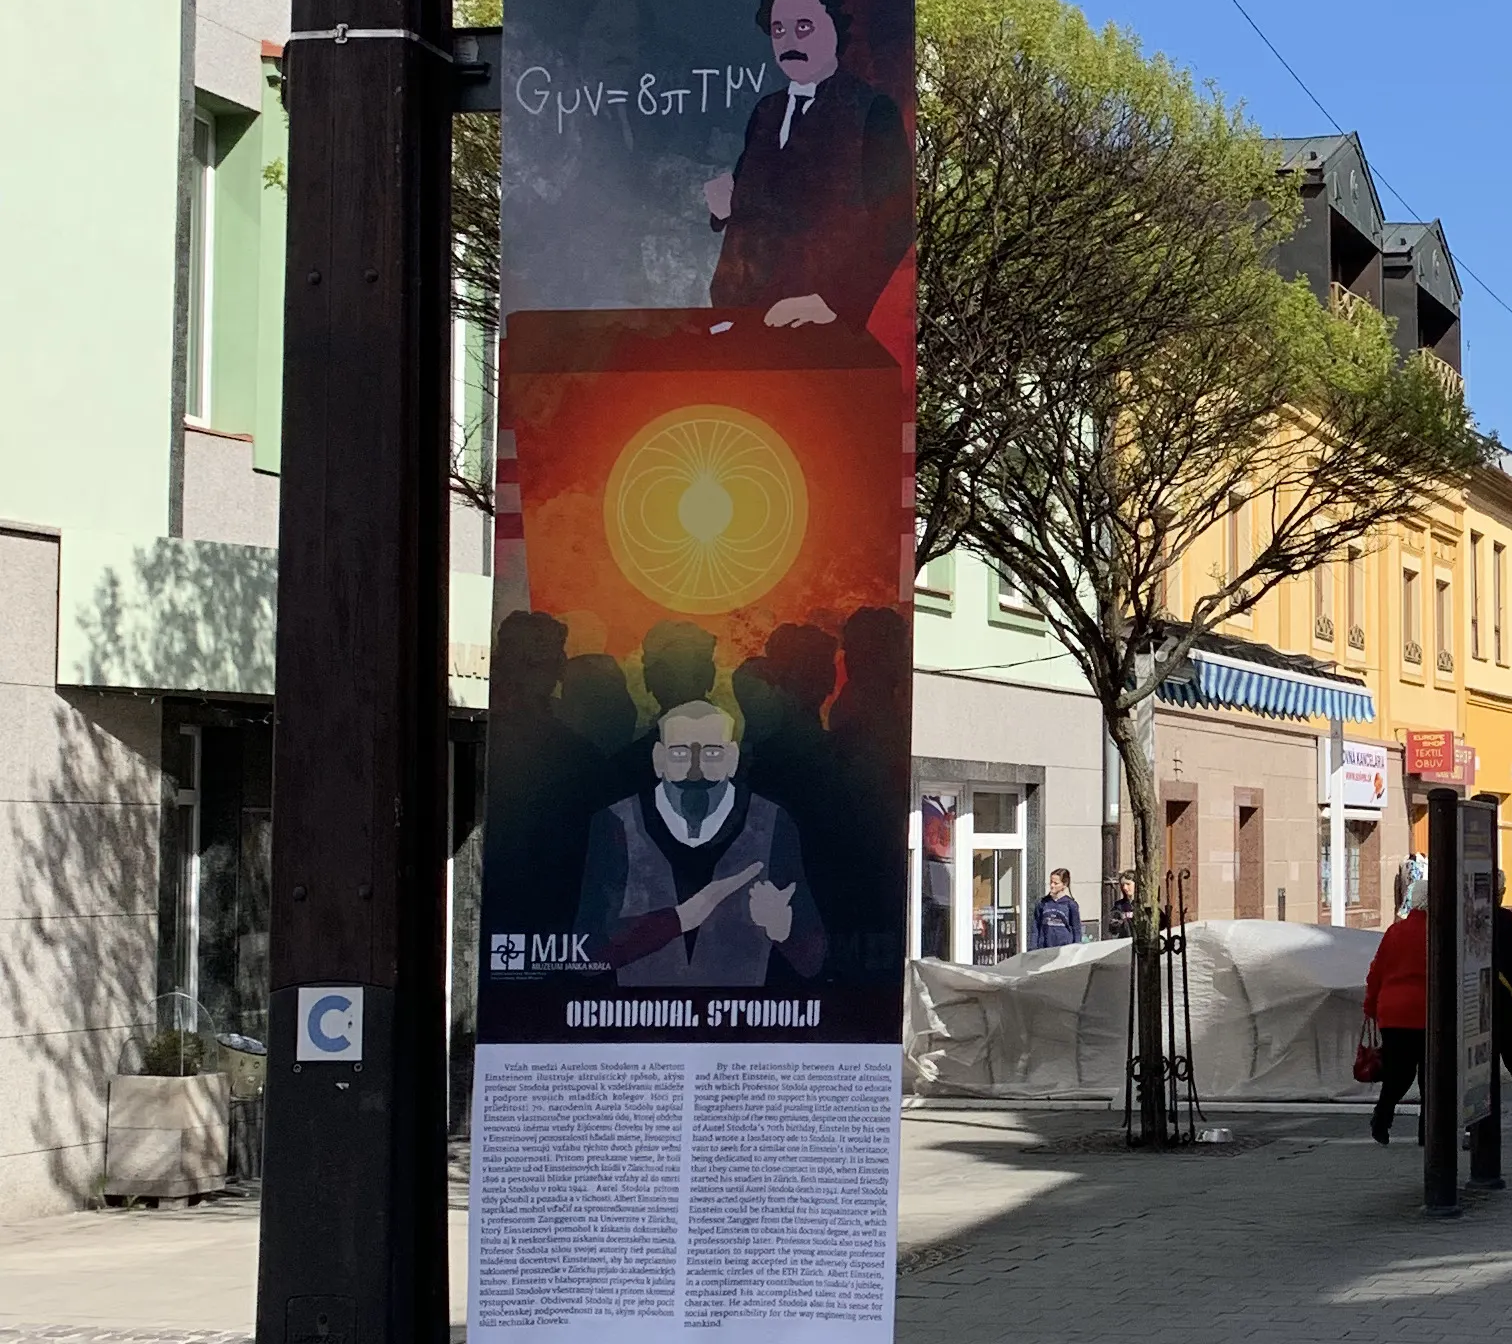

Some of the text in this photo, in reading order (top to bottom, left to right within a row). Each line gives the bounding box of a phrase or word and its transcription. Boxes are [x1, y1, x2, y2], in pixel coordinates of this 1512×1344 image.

[1415, 749, 1443, 757] TEXTIL
[1415, 759, 1443, 768] OBUV
[531, 934, 590, 962] MJK
[531, 962, 563, 971] MUZEUM
[566, 999, 821, 1027] OBDIVOVAL STODOLU
